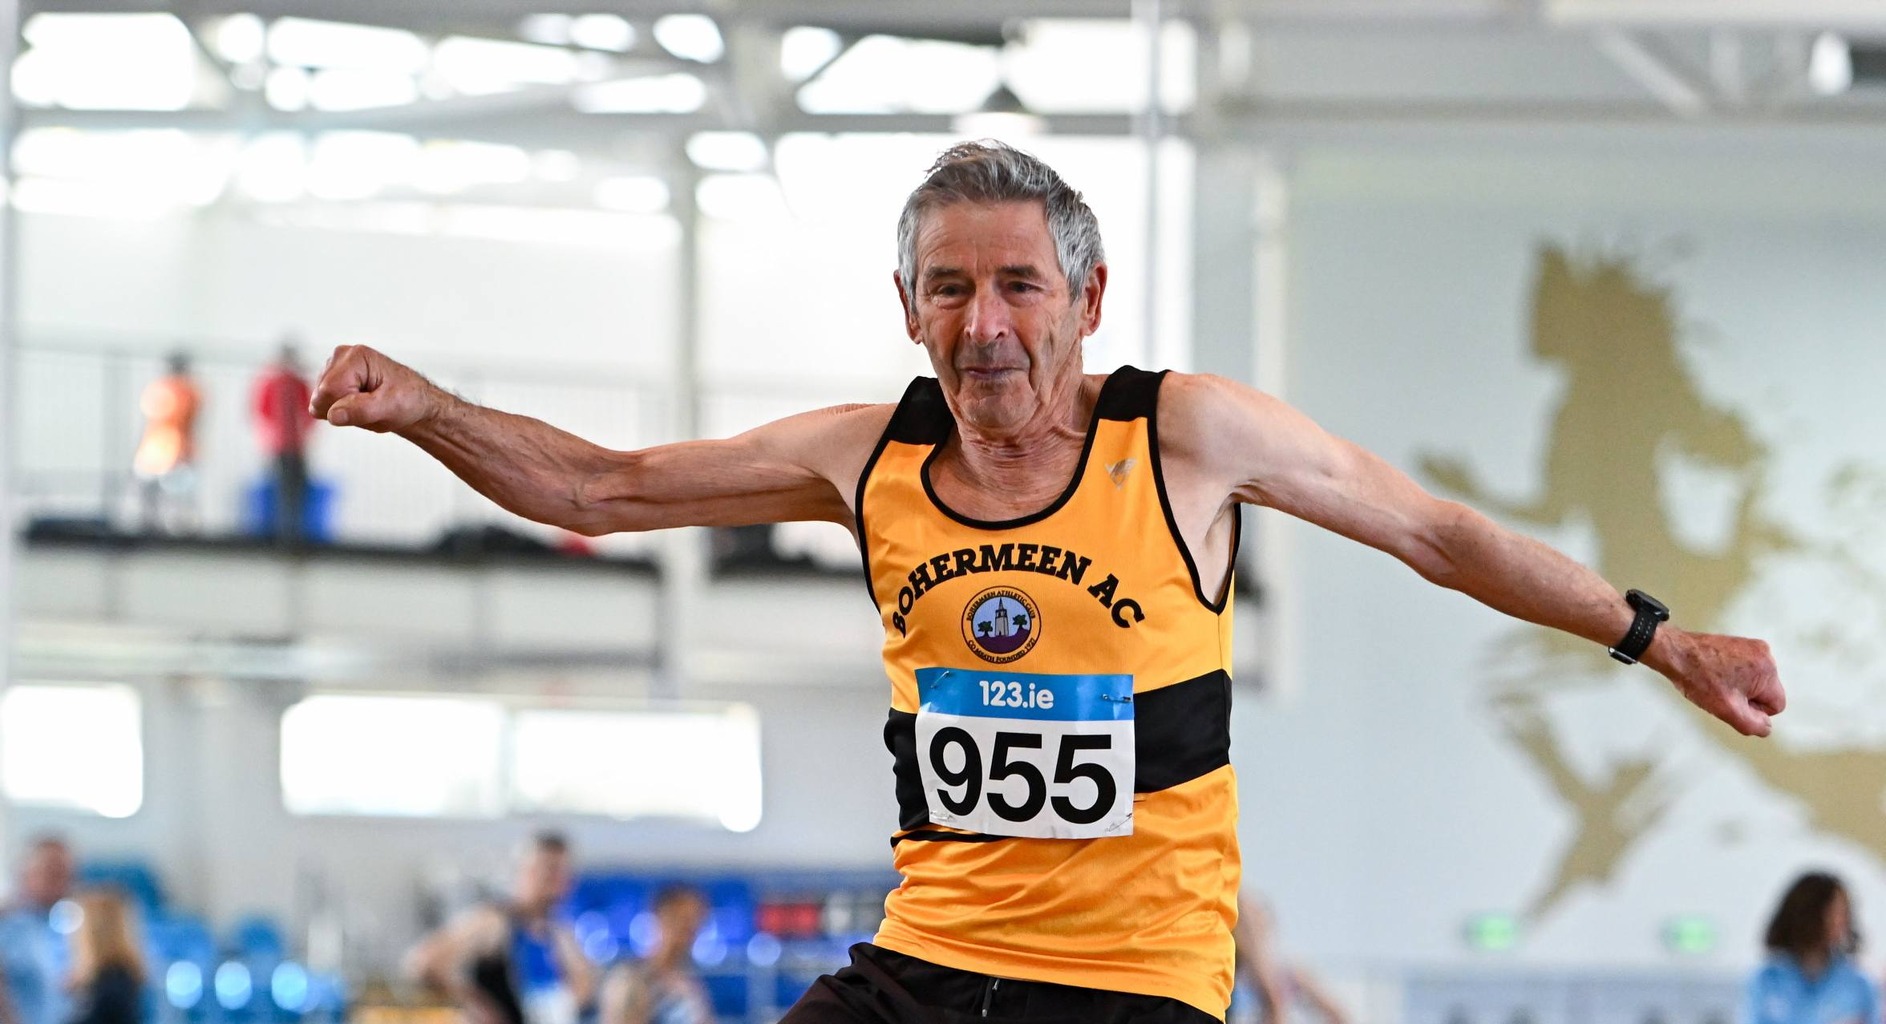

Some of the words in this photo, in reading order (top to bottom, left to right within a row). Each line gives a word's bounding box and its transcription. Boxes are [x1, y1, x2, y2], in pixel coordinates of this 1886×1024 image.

[892, 543, 1092, 639] BOHERMEEN
[1087, 573, 1145, 628] AC
[979, 680, 1054, 709] 123.ie
[929, 726, 1117, 824] 955
